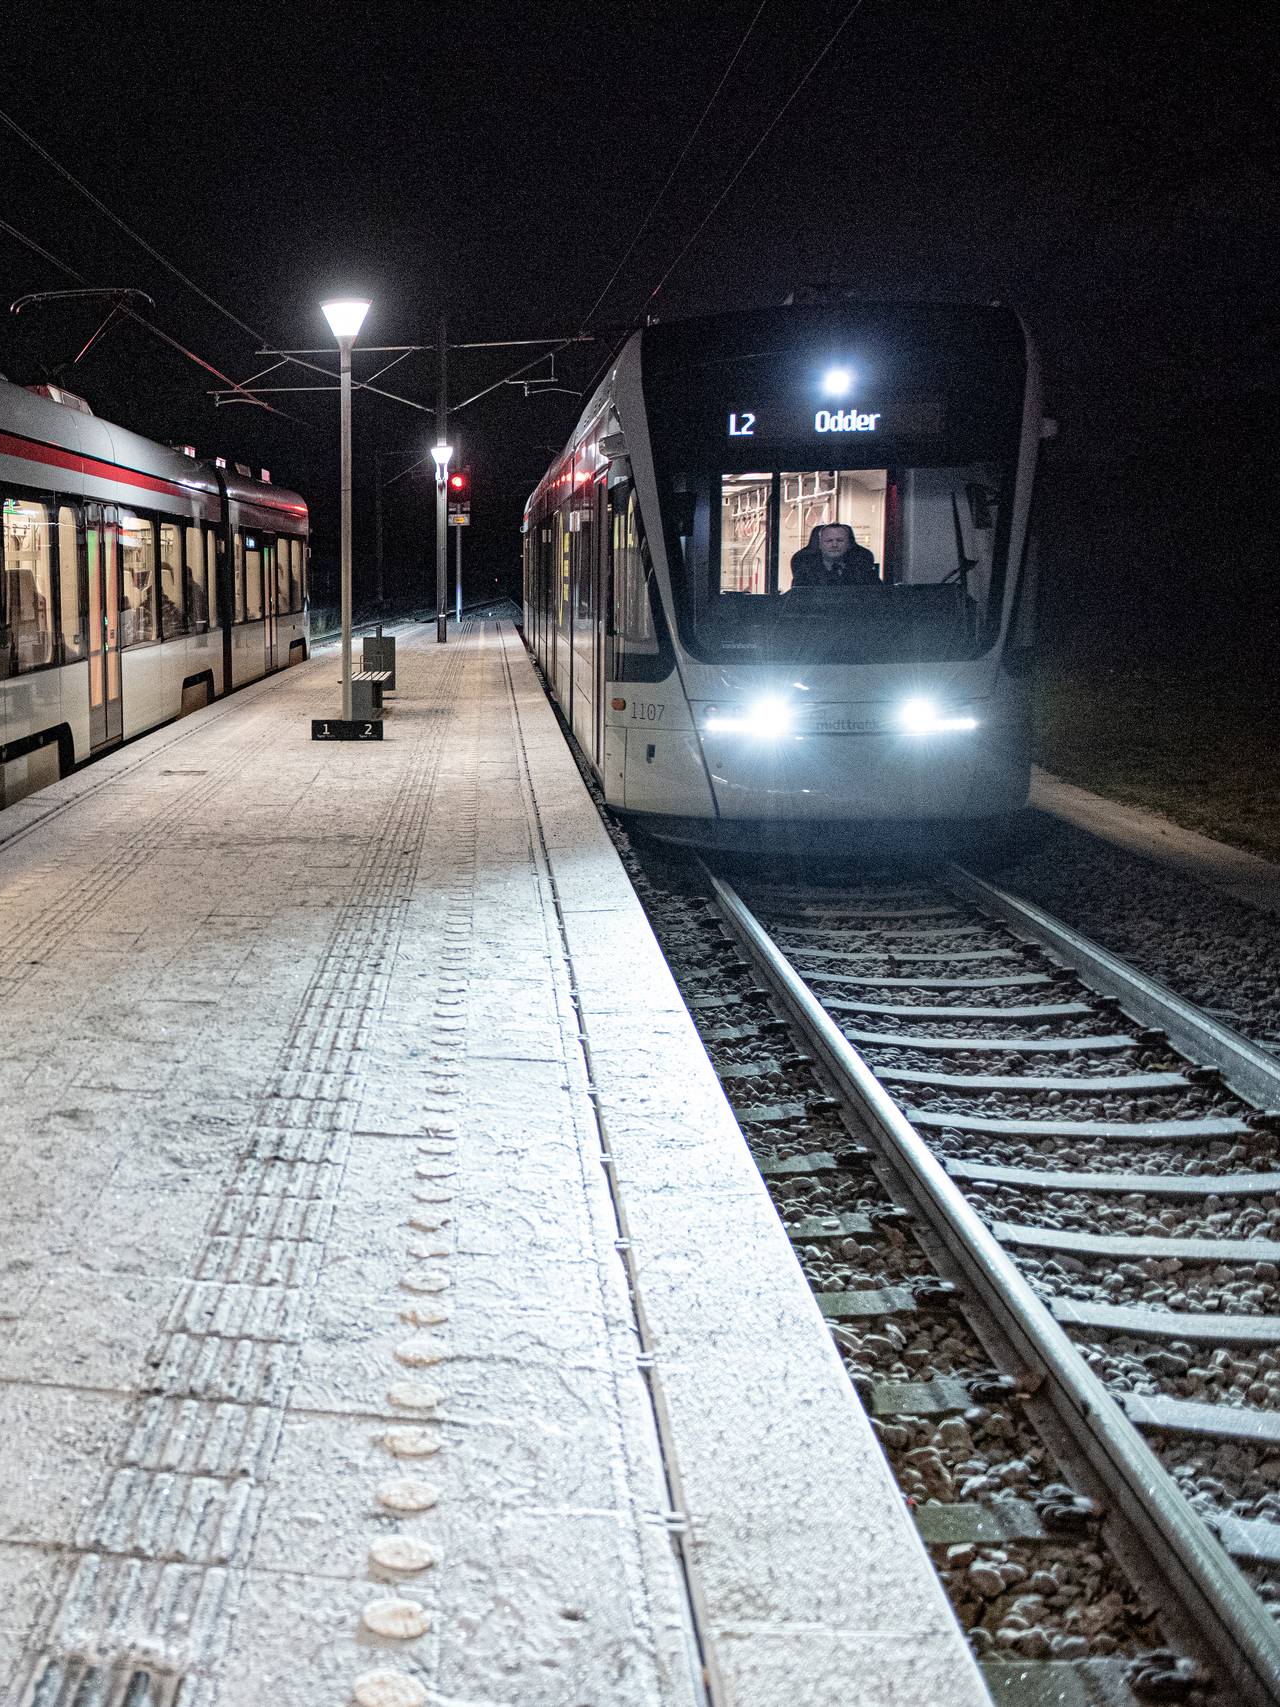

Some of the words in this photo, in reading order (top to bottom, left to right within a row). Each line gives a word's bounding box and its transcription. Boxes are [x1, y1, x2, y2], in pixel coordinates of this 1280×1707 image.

[729, 413, 755, 436] L2
[815, 410, 881, 433] Odder
[631, 702, 665, 721] 1107
[322, 723, 331, 735] 1
[364, 723, 373, 735] 2
